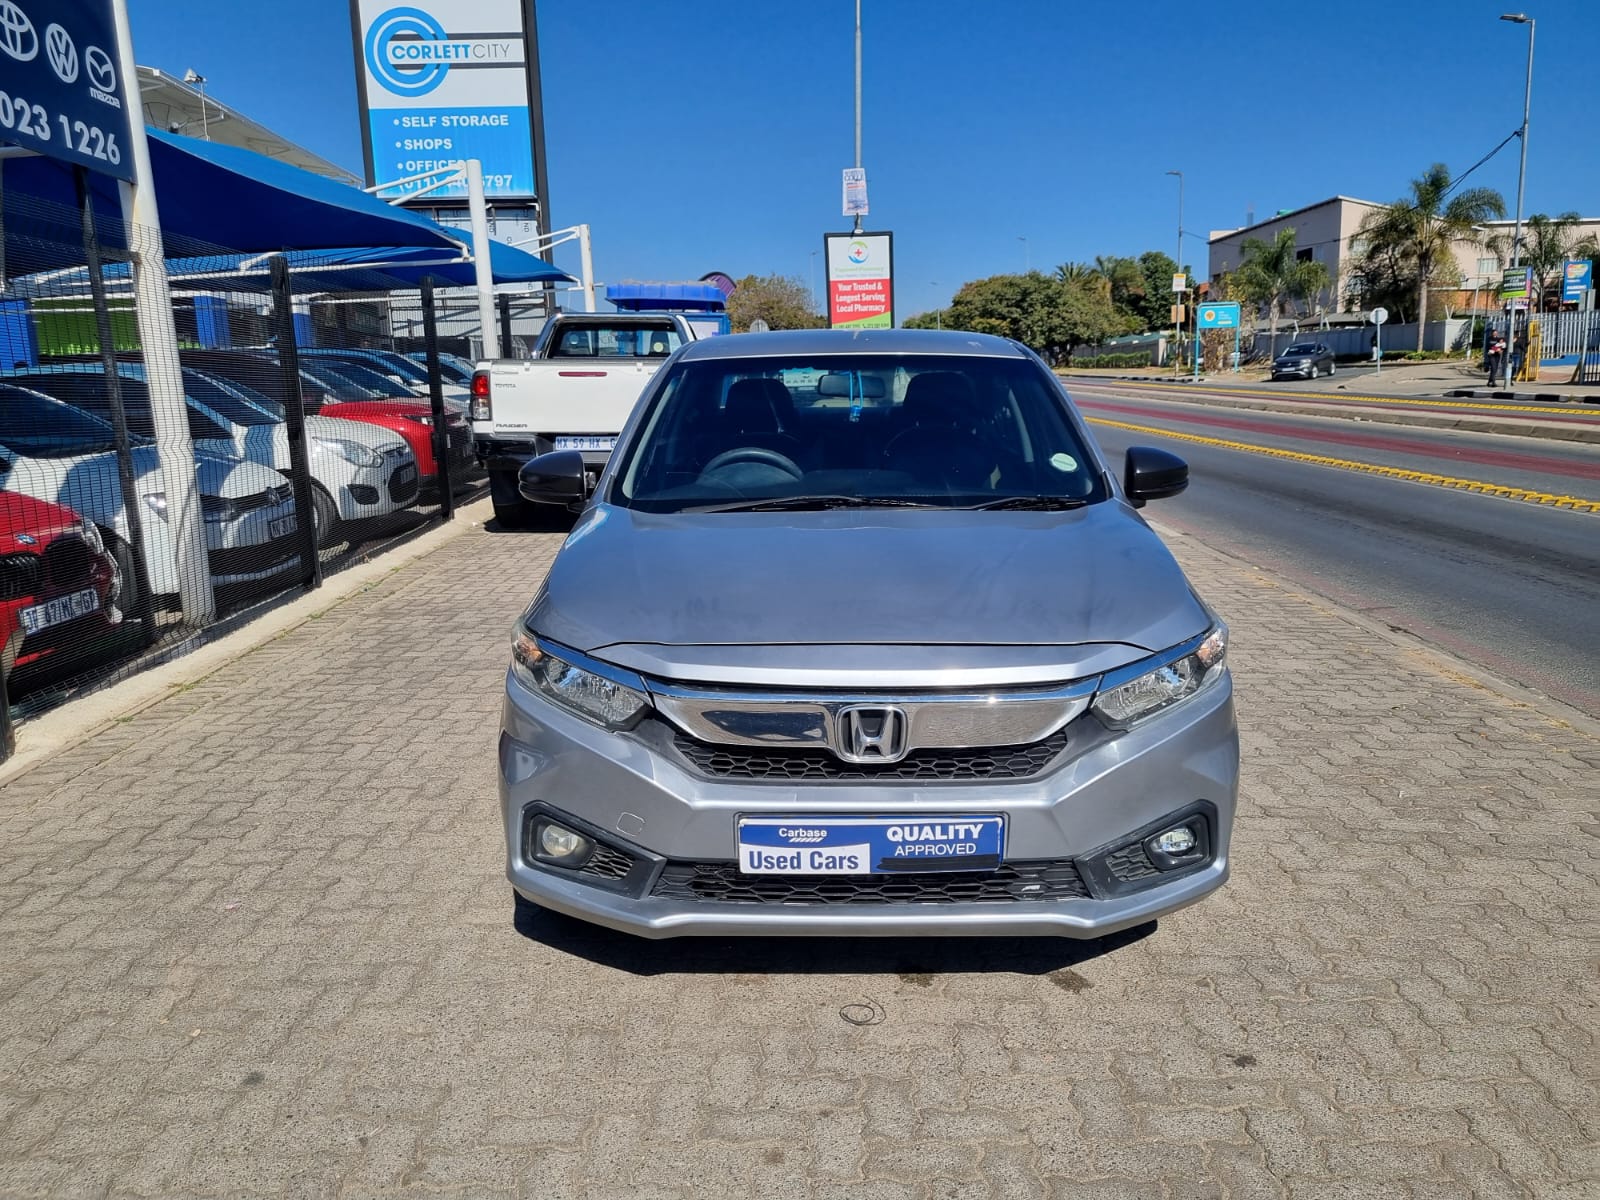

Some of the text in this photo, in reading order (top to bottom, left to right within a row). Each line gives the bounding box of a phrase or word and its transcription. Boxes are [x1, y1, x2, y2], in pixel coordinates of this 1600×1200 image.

[402, 114, 509, 128] SELF STORAGE
[59, 114, 120, 165] 1226
[404, 138, 453, 150] SHOPS
[838, 283, 852, 291] Your
[853, 282, 877, 291] Trusted
[836, 293, 885, 303] Longest Serving
[836, 304, 885, 313] Local Pharmacy
[573, 438, 585, 449] 59
[778, 824, 983, 842] Carbase QUALITY
[895, 843, 976, 857] APPROVED
[749, 850, 859, 871] Used Cars
